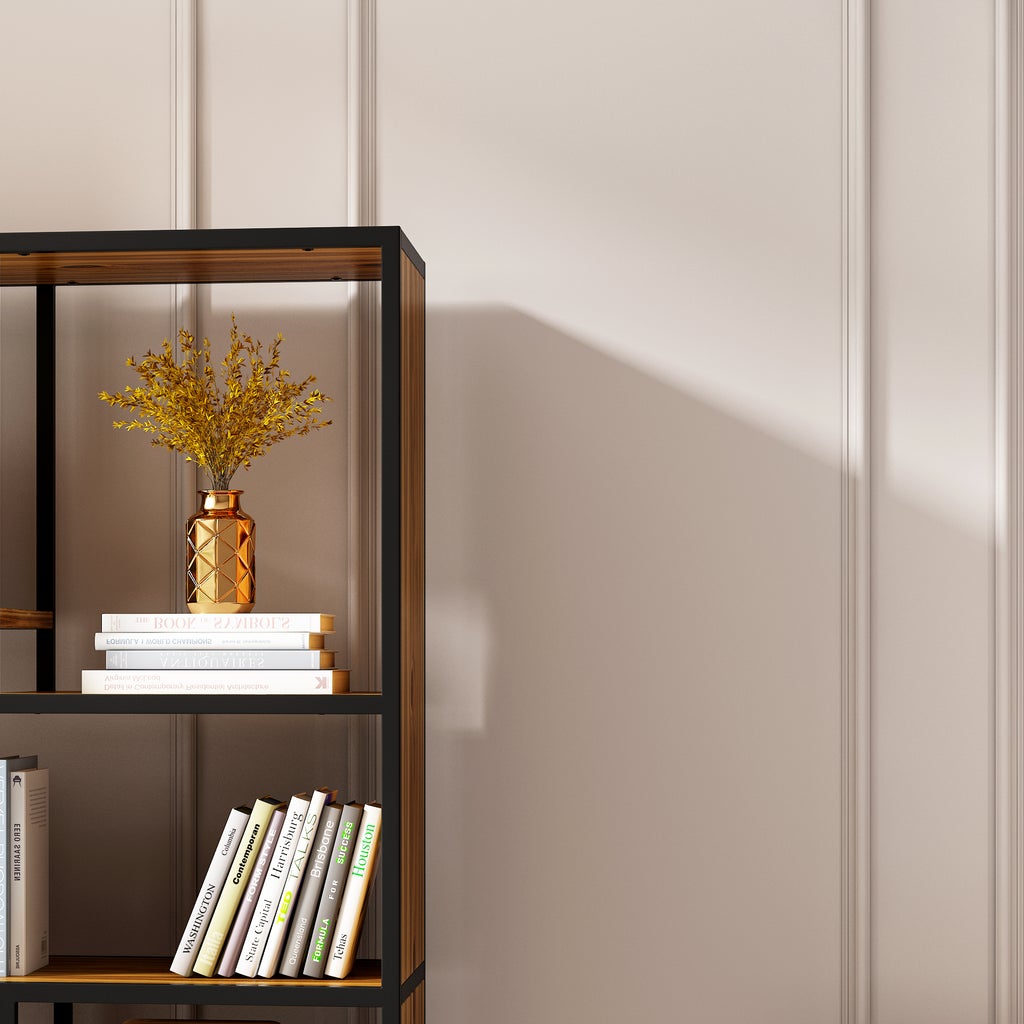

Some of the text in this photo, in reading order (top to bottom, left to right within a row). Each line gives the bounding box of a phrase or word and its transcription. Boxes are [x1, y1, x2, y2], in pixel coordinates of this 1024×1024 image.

[182, 828, 237, 954] WASHINGTON Columbia
[232, 824, 260, 885] Contemporan
[245, 811, 304, 962] State Capital Harrisburg
[246, 828, 276, 902] FORM STYLE
[277, 813, 317, 924] TED TALKS
[288, 820, 335, 965] Queensland Brisbane
[312, 821, 354, 963] FORMULA FOR SUCCESS
[351, 823, 375, 878] Houston
